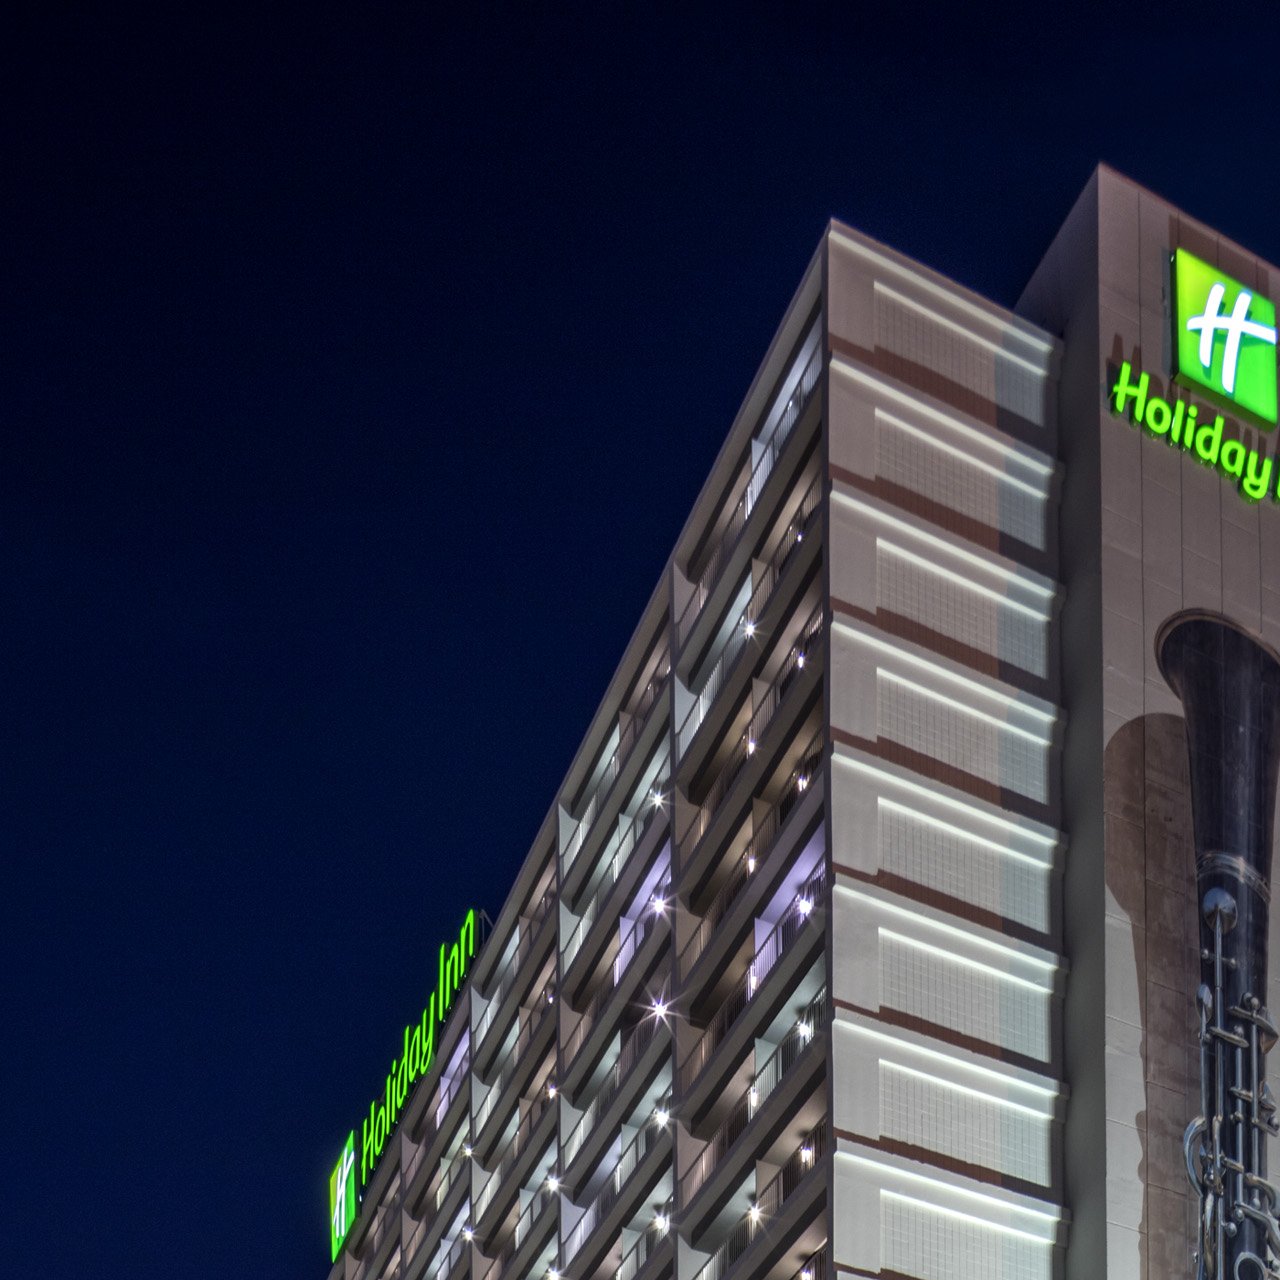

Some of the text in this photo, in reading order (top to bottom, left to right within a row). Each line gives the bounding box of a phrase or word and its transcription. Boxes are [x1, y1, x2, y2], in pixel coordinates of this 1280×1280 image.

[1113, 361, 1272, 499] Holiday
[361, 908, 475, 1186] Holiday Inn
